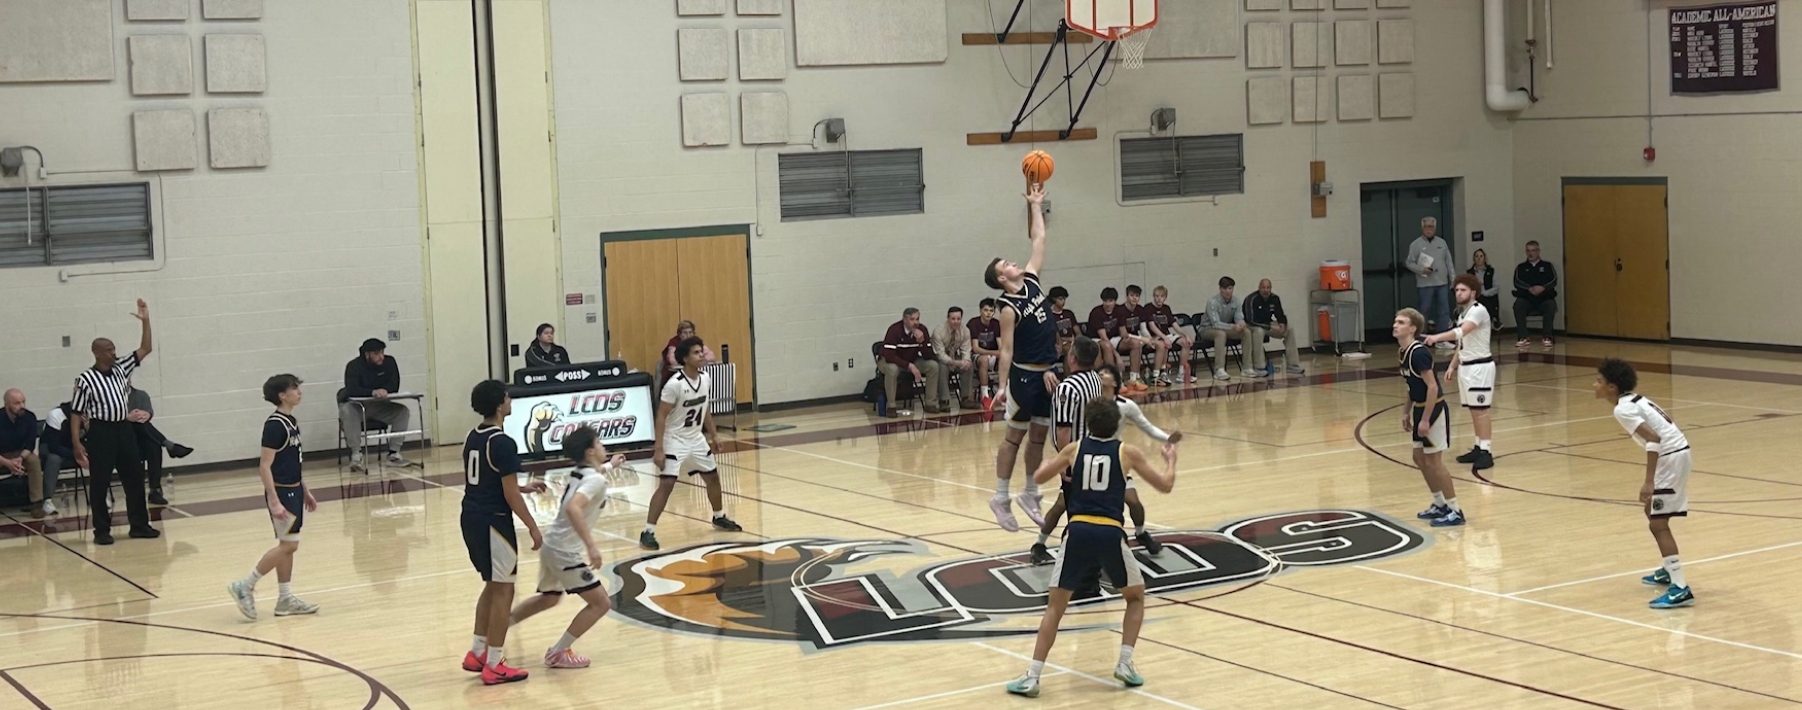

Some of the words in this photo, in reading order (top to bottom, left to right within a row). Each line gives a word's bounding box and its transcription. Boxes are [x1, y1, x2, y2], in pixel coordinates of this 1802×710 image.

[1671, 9, 1712, 24] ACADEMIC
[1713, 4, 1776, 21] ALL-AMERICAN
[563, 371, 582, 380] POSS
[567, 390, 626, 416] LCDS
[684, 407, 702, 427] 24
[467, 450, 480, 485] 0
[1082, 454, 1111, 491] 10
